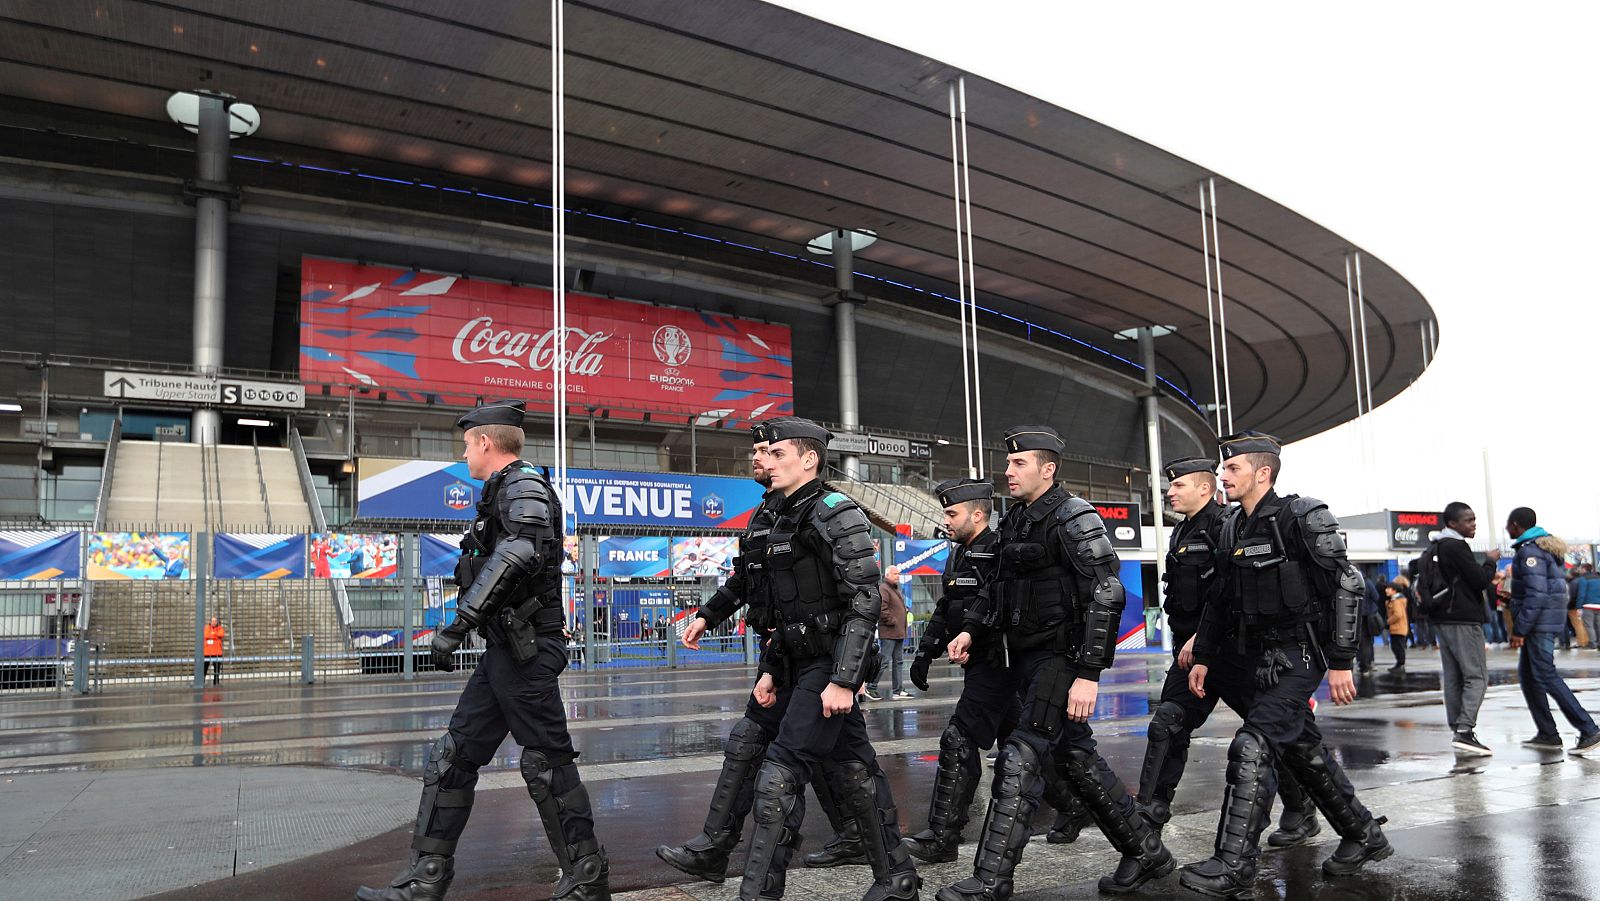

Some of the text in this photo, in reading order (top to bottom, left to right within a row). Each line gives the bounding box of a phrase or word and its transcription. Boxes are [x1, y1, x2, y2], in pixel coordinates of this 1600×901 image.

[452, 316, 611, 376] Coca-Cola
[138, 378, 218, 391] Tribune Haute
[484, 376, 586, 393] PARTENAIRE OFCIEL
[649, 374, 695, 386] EURO2016
[155, 388, 217, 400] Upper Stand
[661, 384, 684, 392] FRANCE
[223, 387, 297, 404] S 15 16 17 18
[869, 441, 877, 453] U
[551, 484, 693, 519] NVENUE
[608, 550, 659, 562] FRANCE
